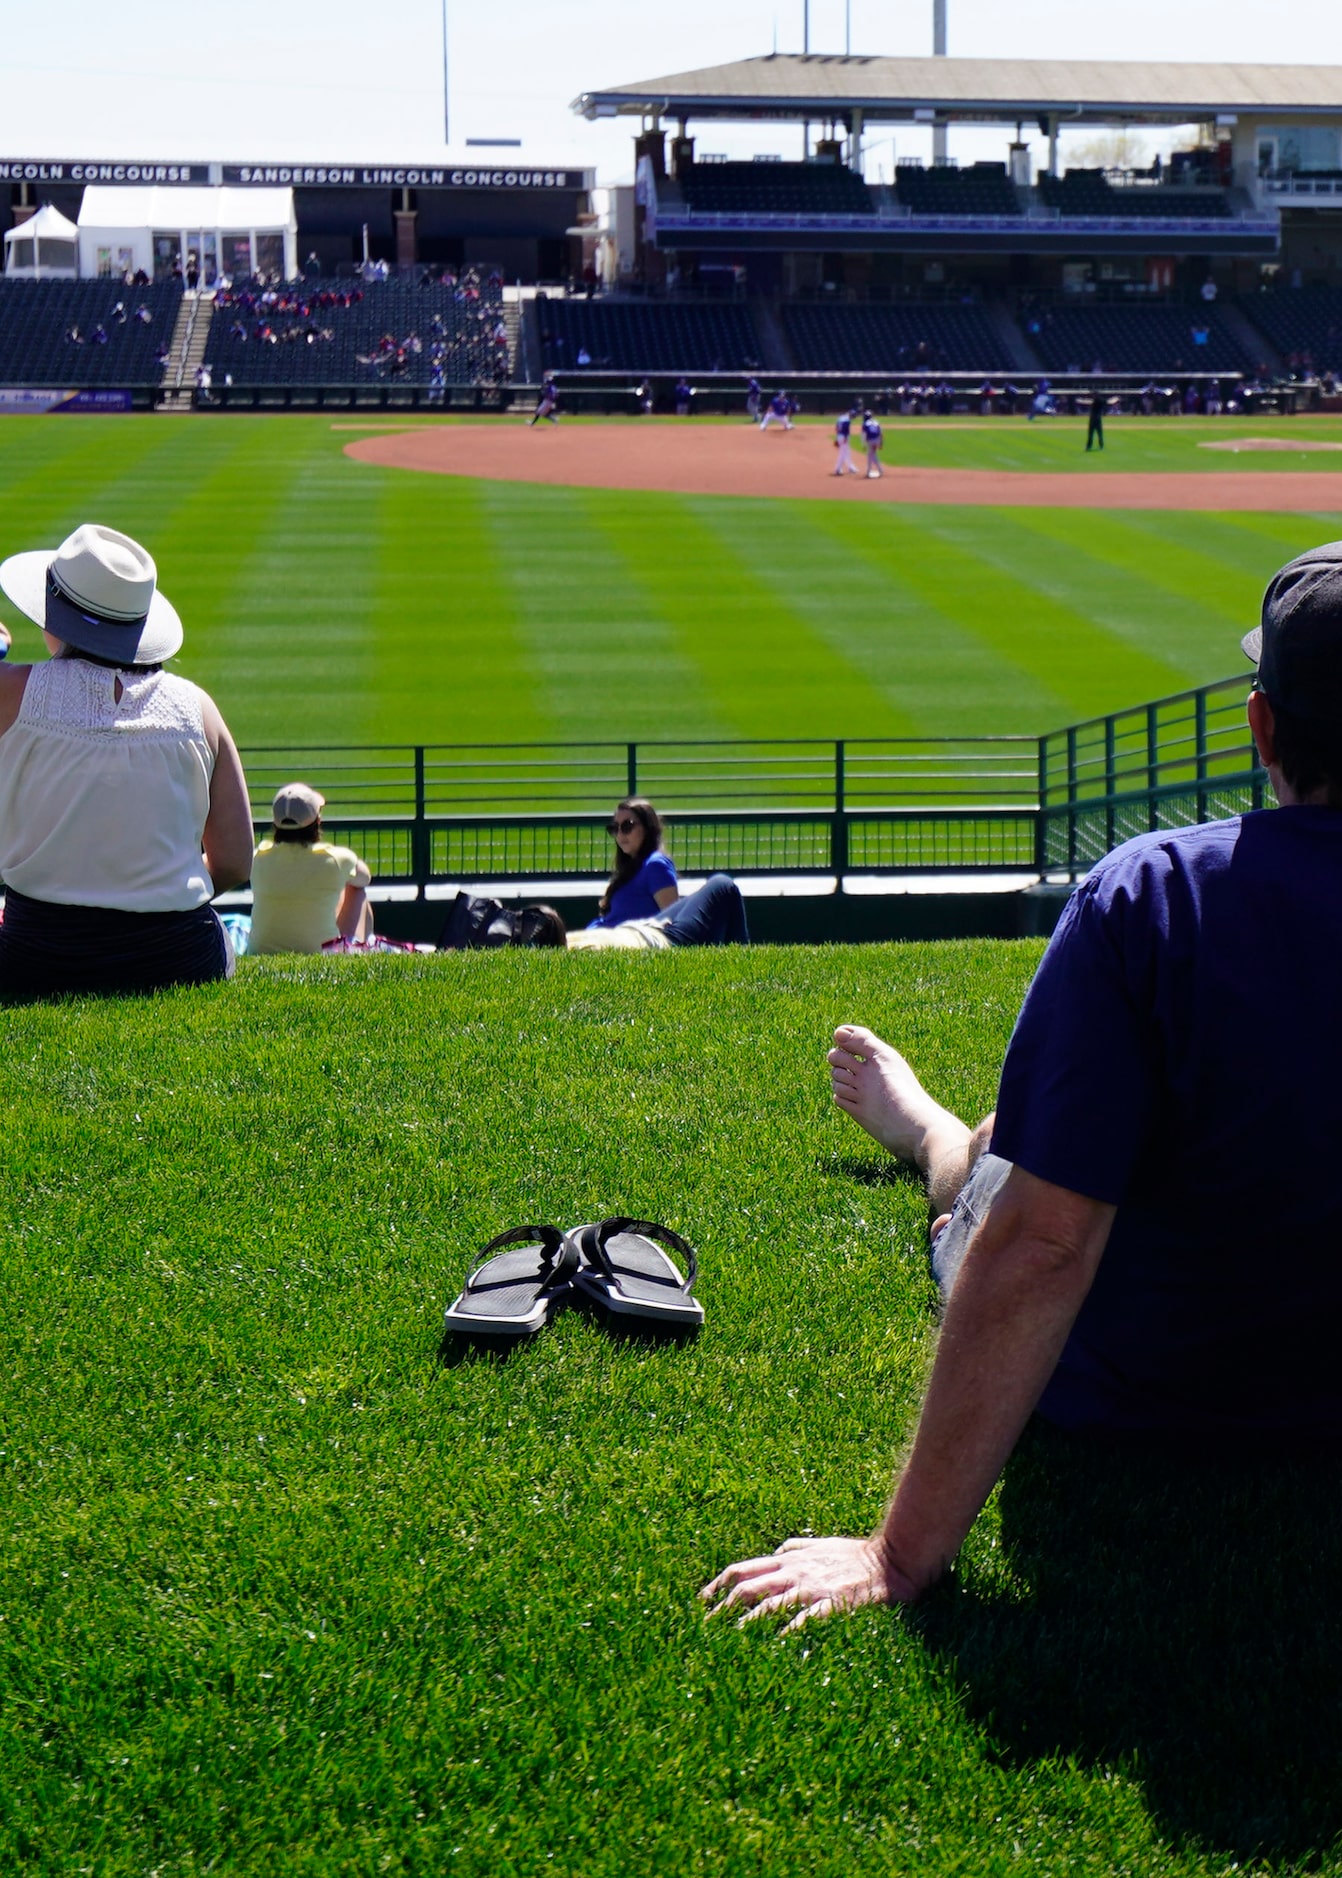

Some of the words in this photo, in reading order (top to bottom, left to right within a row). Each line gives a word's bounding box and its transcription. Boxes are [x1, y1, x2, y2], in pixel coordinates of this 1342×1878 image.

[71, 164, 191, 181] CONCOURSE
[239, 167, 355, 183] SANDERSON
[362, 169, 444, 185] LINCOLN
[451, 170, 567, 187] CONCOURSE
